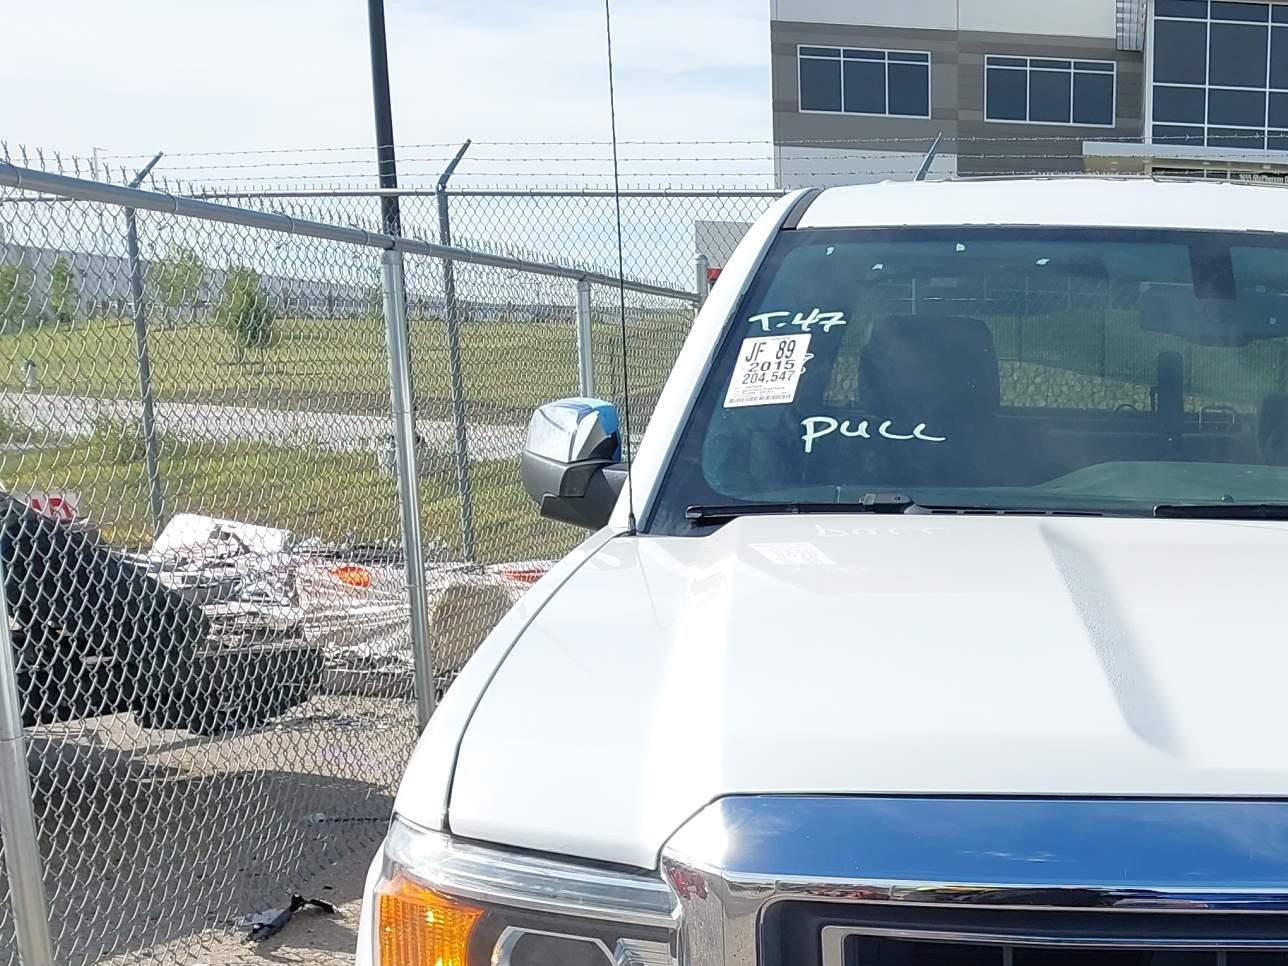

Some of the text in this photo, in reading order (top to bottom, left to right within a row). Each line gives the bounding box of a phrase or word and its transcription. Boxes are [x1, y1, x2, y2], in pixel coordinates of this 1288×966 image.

[745, 340, 797, 362] JF 89
[748, 360, 796, 373] 2015
